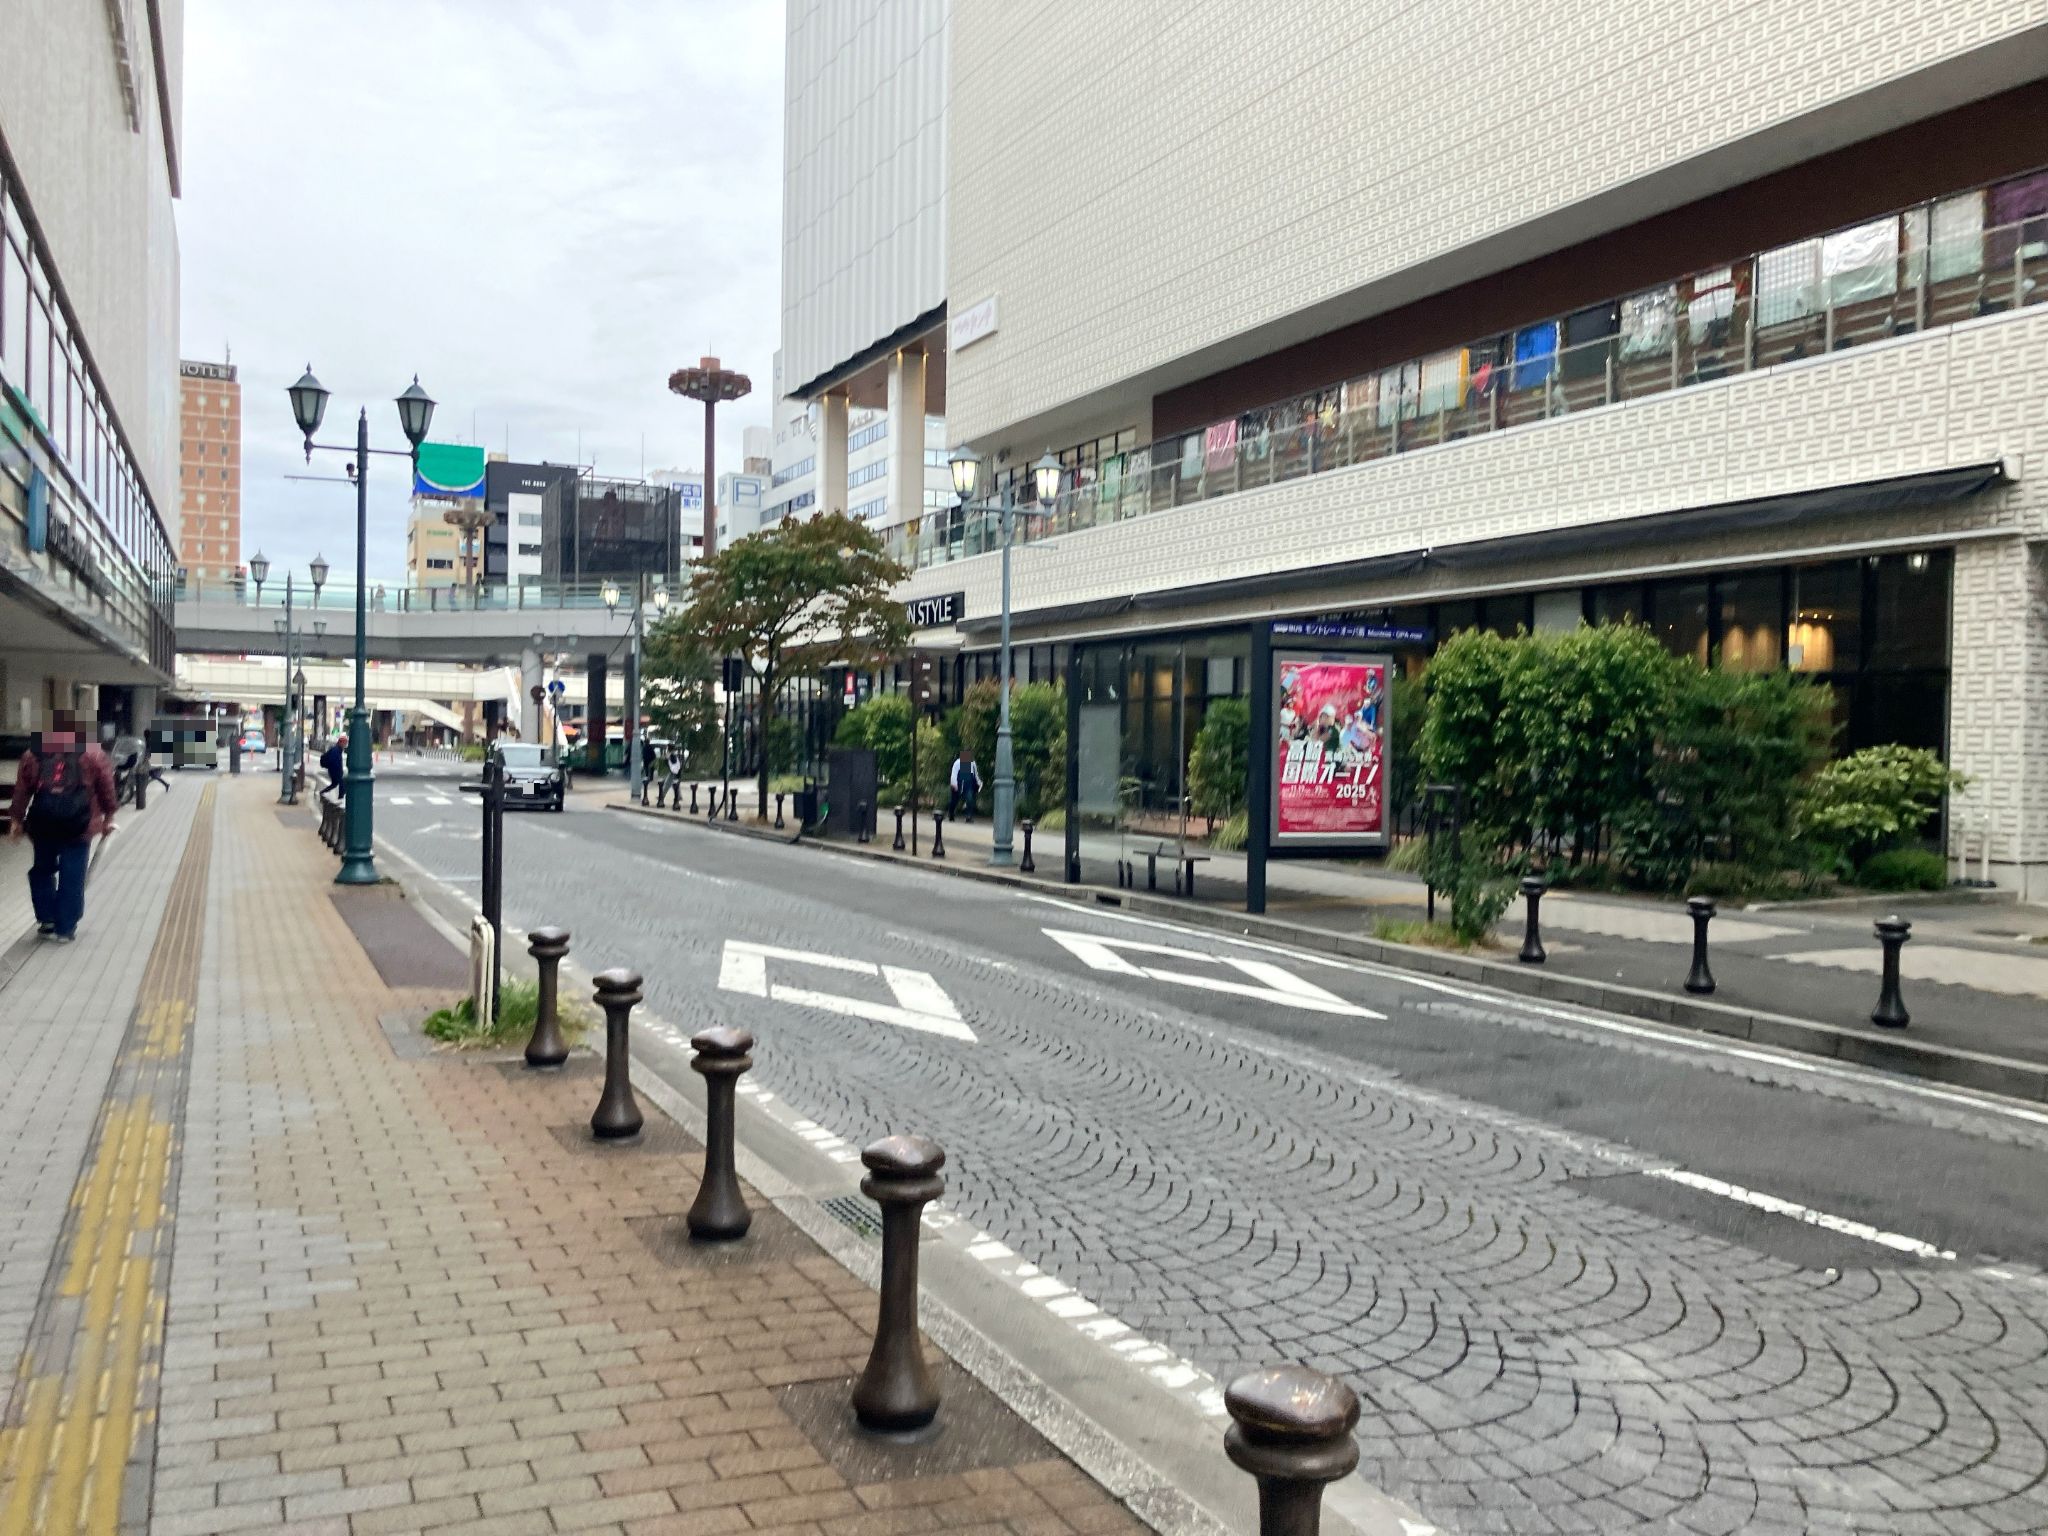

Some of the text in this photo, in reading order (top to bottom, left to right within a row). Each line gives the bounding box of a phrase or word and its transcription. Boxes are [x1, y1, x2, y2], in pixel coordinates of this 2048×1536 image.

[735, 482, 758, 502] P
[918, 597, 952, 626] STYLE
[1335, 784, 1366, 799] 2025
